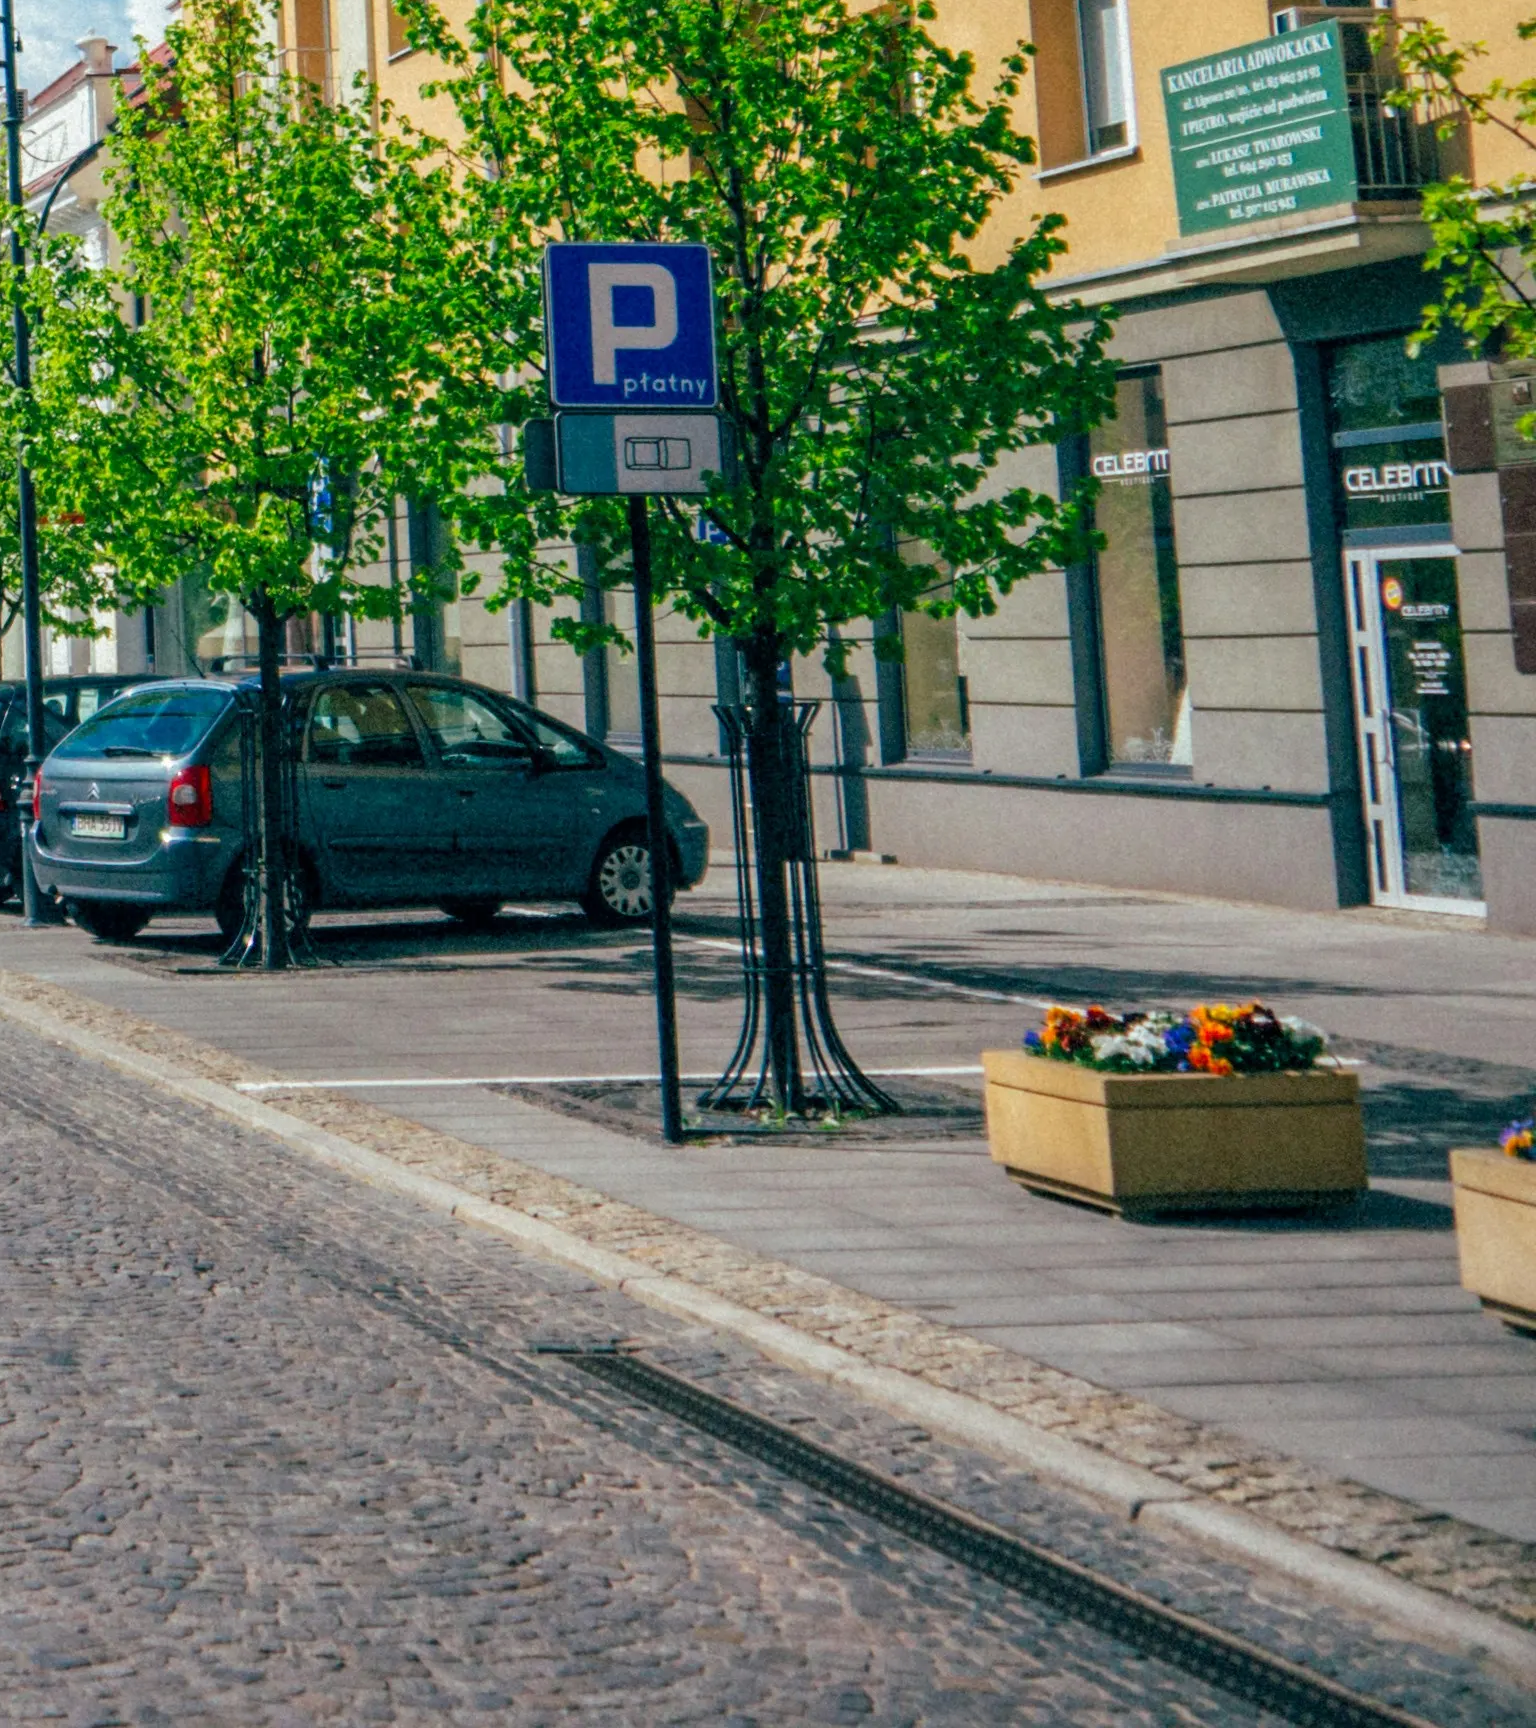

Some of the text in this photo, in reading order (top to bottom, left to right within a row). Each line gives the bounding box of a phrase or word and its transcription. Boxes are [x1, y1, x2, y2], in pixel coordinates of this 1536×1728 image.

[1168, 32, 1331, 93] KANCELARIA ADWOKACKA
[1252, 78, 1267, 91] tel.
[1263, 98, 1276, 113] od
[1252, 126, 1322, 154] TWAROWSKI
[1223, 163, 1239, 177] tel.
[1211, 185, 1263, 205] PATRYCJA
[1265, 169, 1330, 194] MURAWSKA
[1229, 205, 1244, 219] tel.
[588, 263, 677, 384] P
[623, 373, 707, 399] płatny
